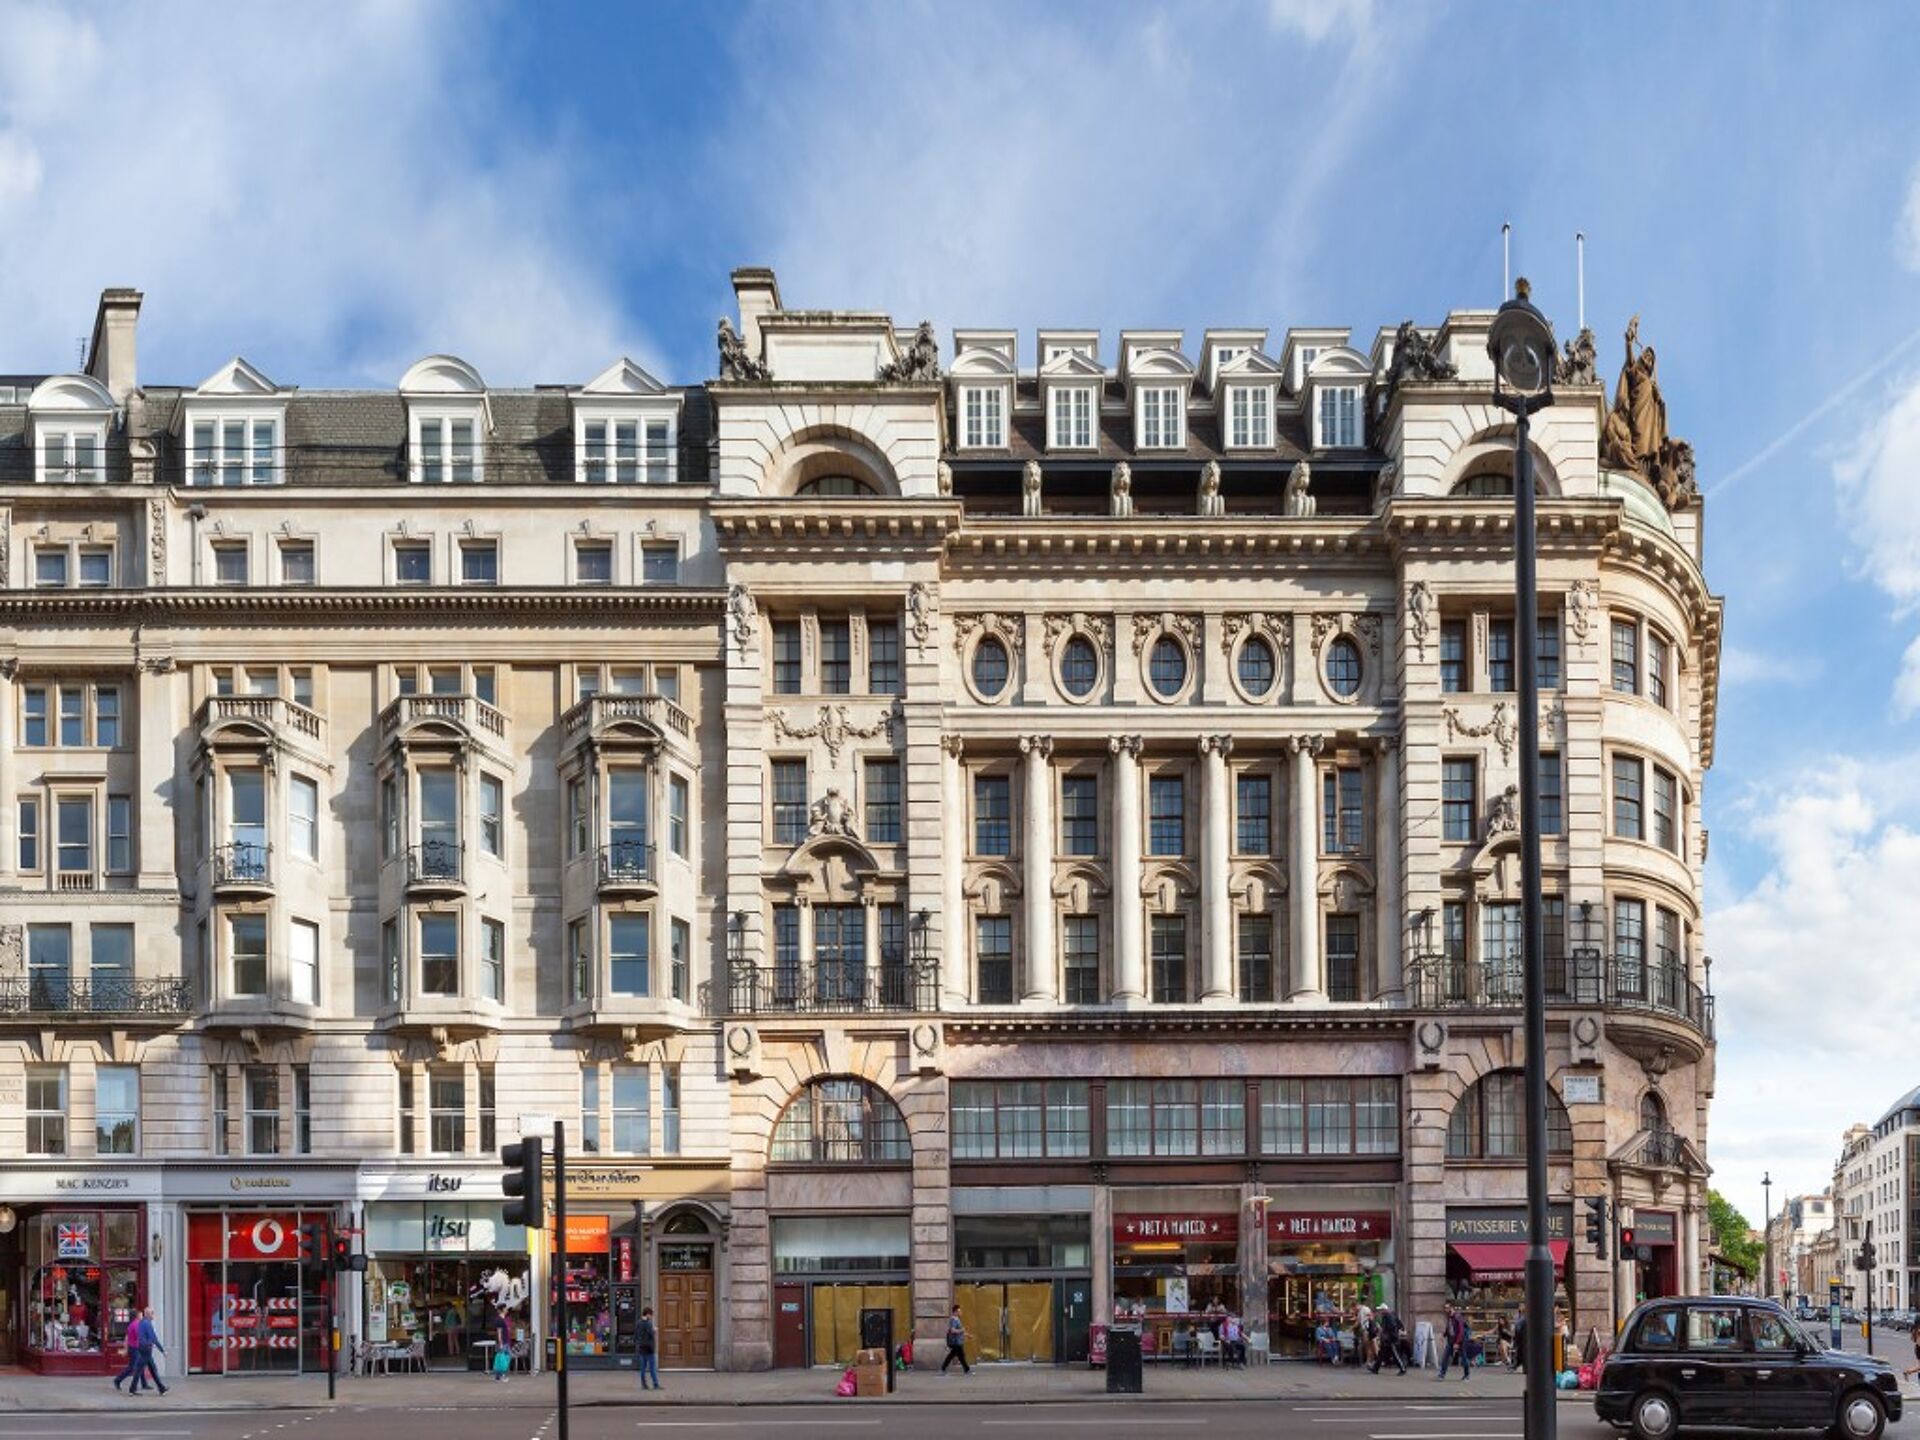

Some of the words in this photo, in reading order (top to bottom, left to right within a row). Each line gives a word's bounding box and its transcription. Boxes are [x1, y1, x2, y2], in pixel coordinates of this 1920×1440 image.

[429, 1173, 461, 1192] itsu
[431, 1214, 471, 1237] itsu
[1139, 1219, 1161, 1235] PRET
[1290, 1218, 1311, 1234] PRET
[1450, 1220, 1518, 1233] PATISSERIE
[1520, 1216, 1564, 1233] VRIE
